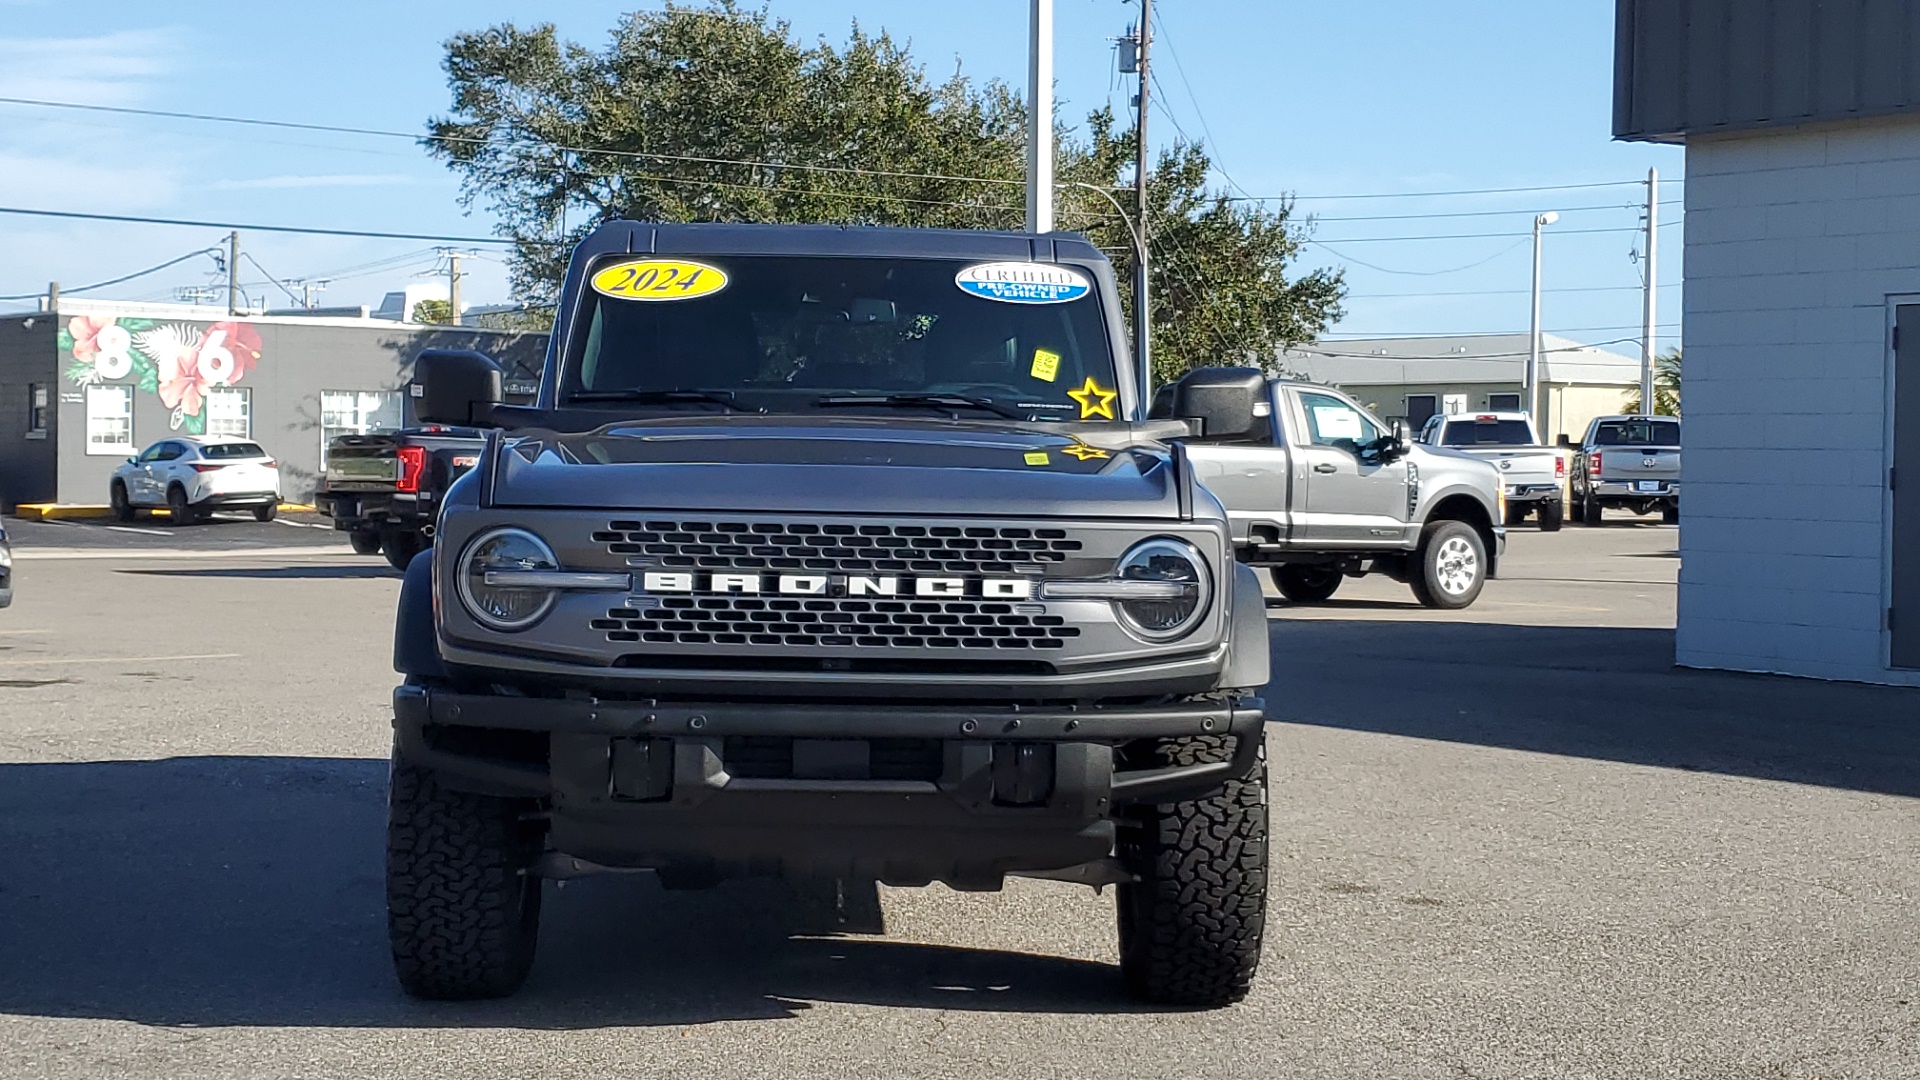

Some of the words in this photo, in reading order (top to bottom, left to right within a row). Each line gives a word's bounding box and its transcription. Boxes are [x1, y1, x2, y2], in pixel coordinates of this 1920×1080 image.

[608, 268, 704, 291] 2024
[970, 269, 1073, 284] CERTIFIED
[977, 282, 1071, 293] PRE-OWNED
[992, 289, 1058, 299] VEHICLE
[644, 572, 1030, 596] BRONCO
